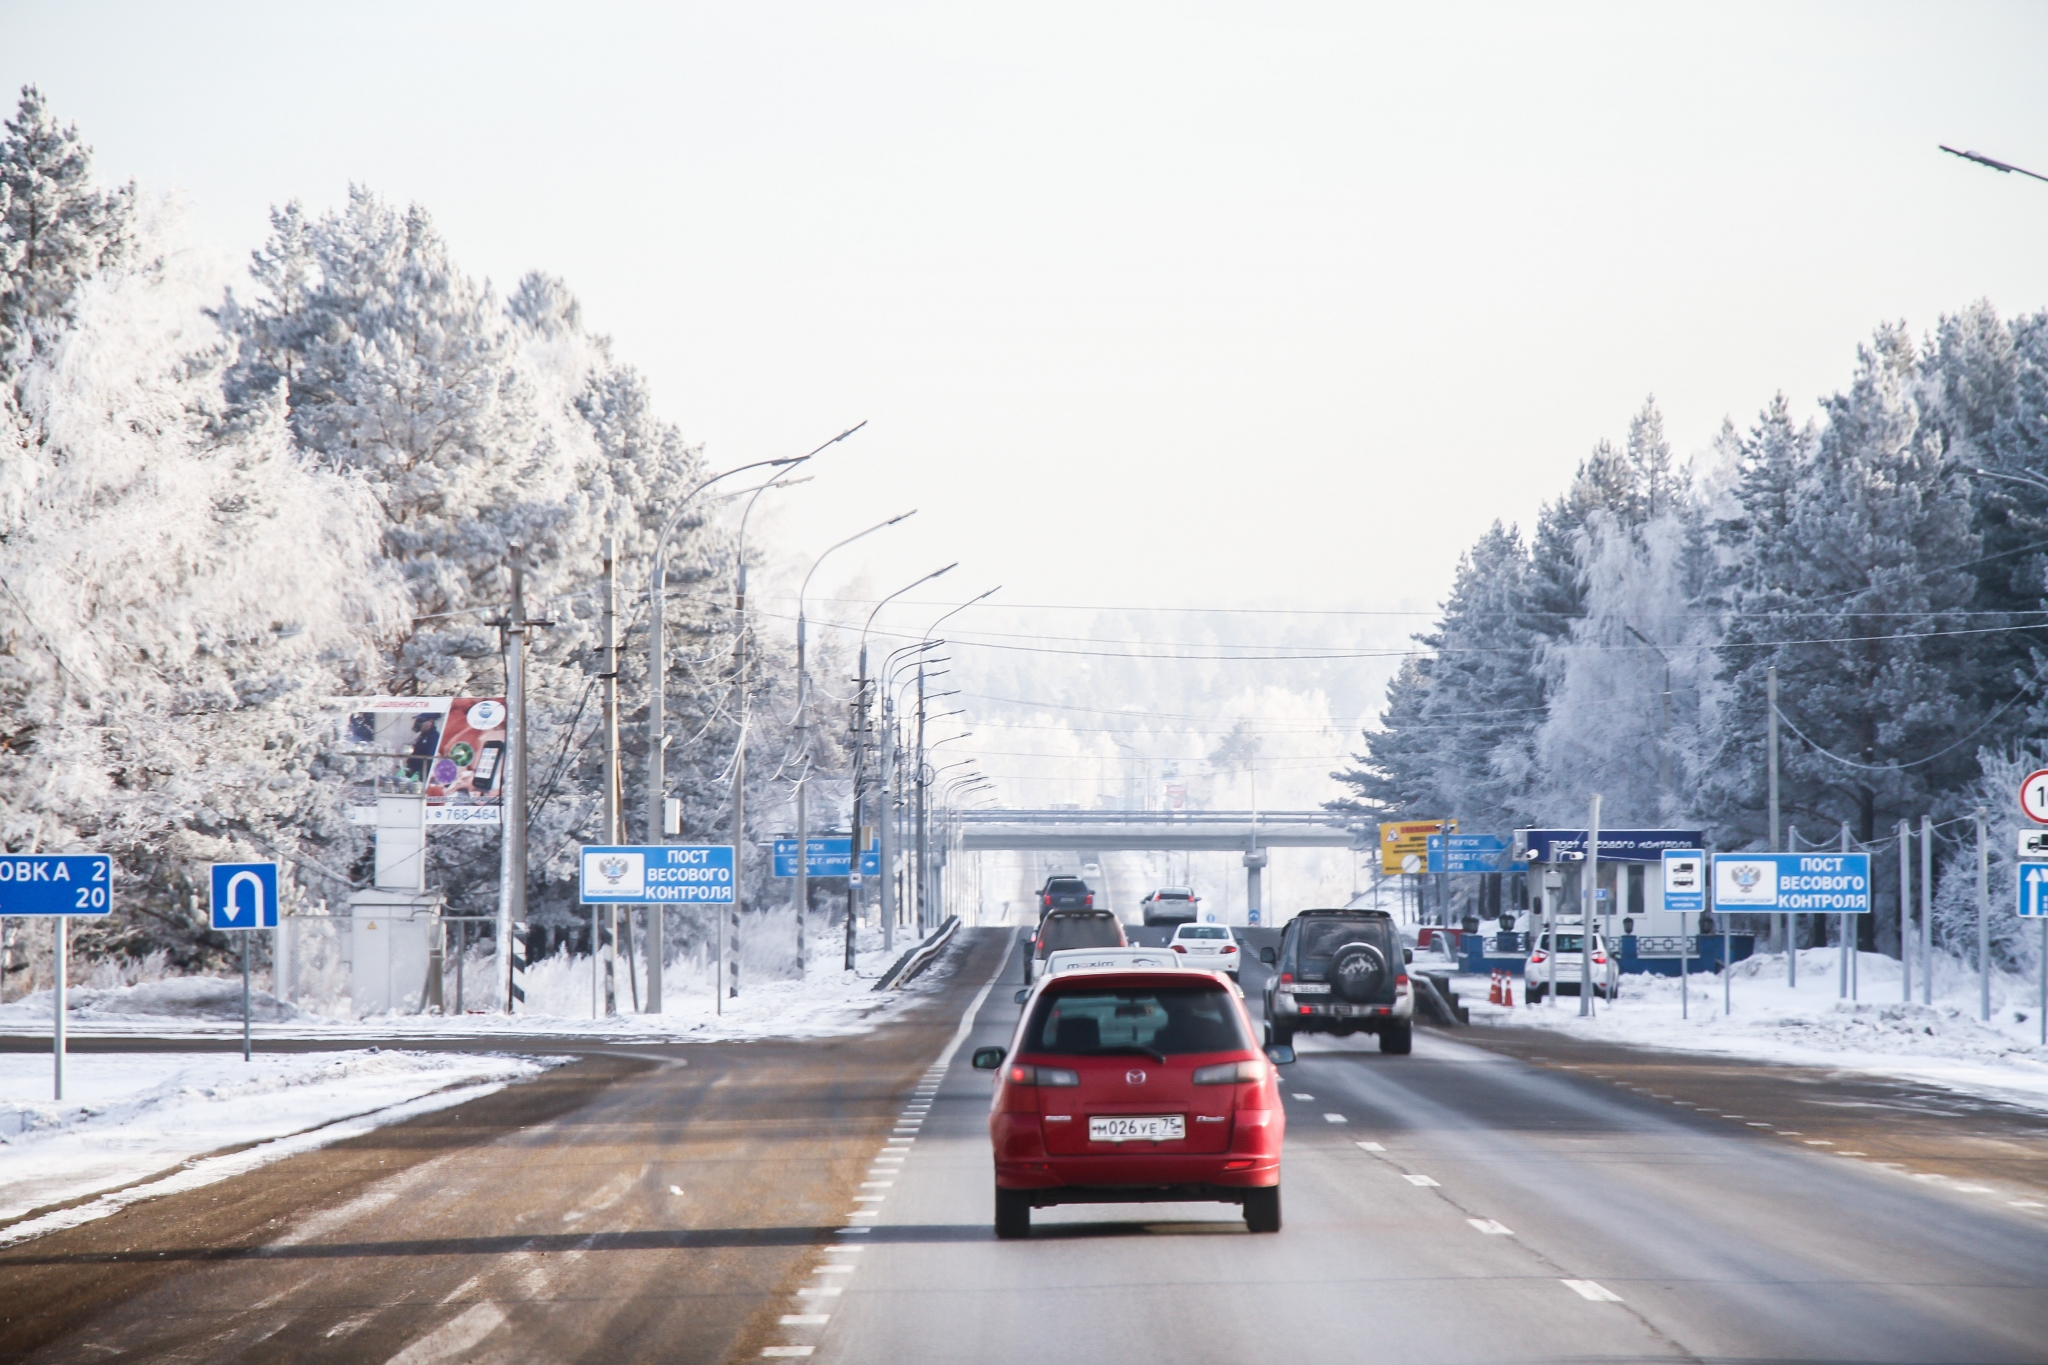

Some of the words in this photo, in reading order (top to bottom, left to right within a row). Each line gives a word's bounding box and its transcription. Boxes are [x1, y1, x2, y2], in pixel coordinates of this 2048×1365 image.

[2037, 786, 2048, 807] 1
[446, 809, 497, 820] 768-464
[788, 843, 825, 851] ИРУТСК
[1442, 839, 1480, 847] РКУТСК
[1582, 840, 1635, 849] ВСОВОГО
[667, 850, 710, 864] ПОСТ
[1801, 857, 1844, 872] ПОСТ
[0, 861, 71, 881] ОВКА
[91, 861, 106, 881] 2
[647, 867, 730, 882] ВЕСОВОГО
[1780, 875, 1865, 890] ВЕСОВОГО
[75, 887, 106, 908] 20
[645, 885, 732, 900] КОНТРОЛЯ
[1778, 894, 1867, 909] КОНТРОЛЯ
[1066, 961, 1115, 970] maxim
